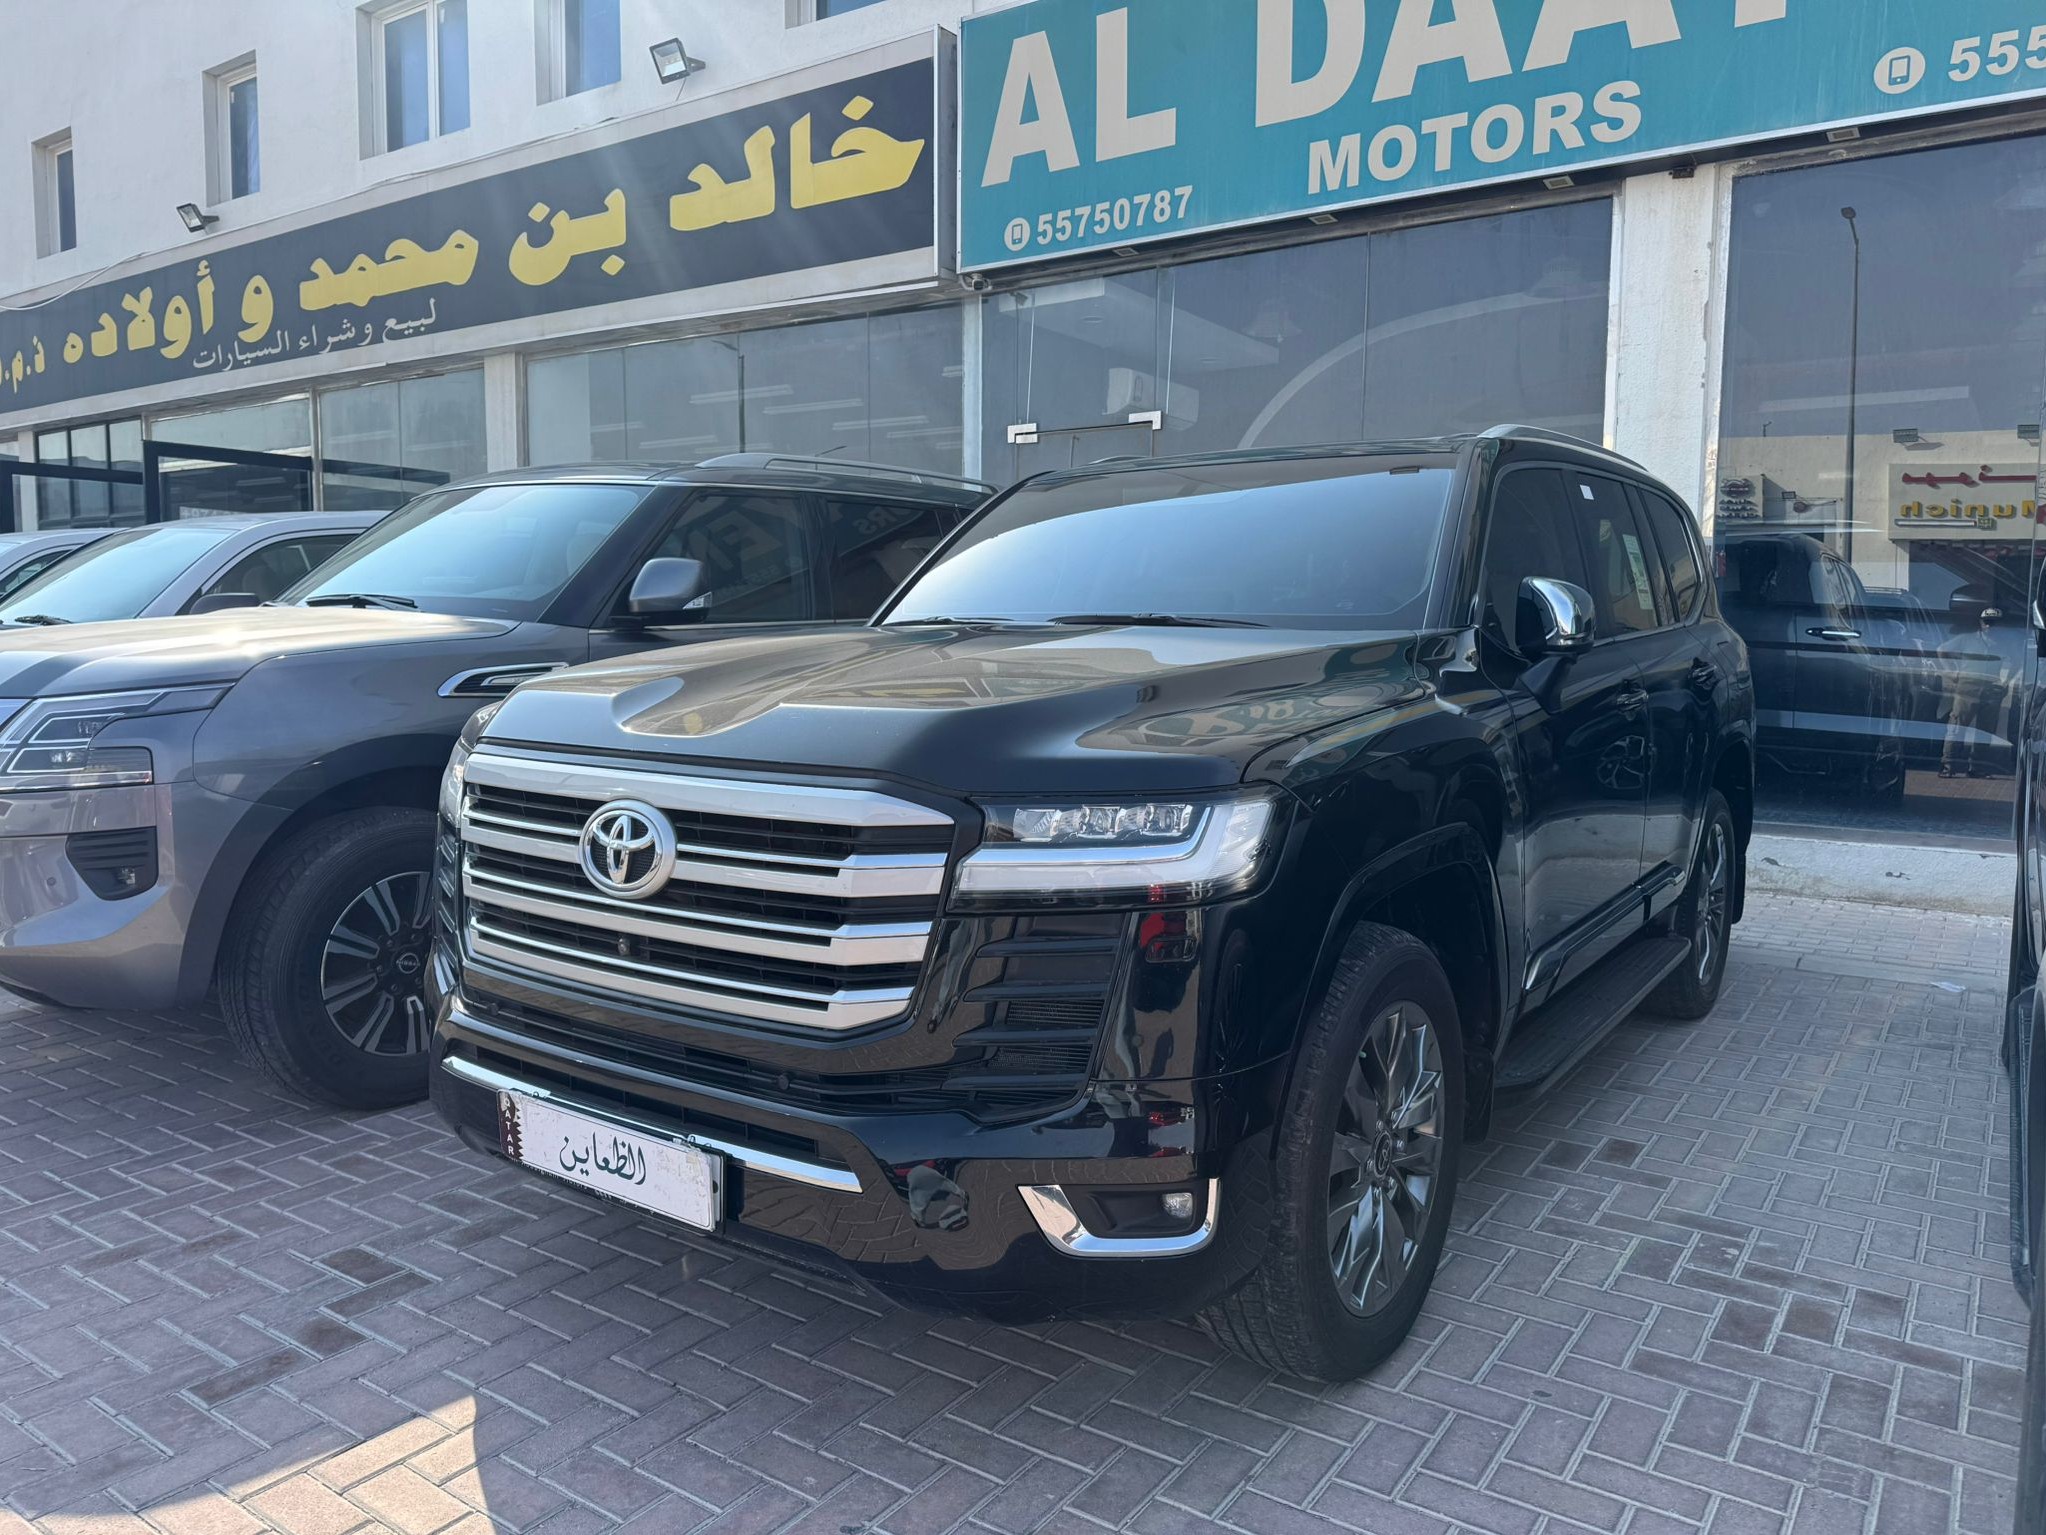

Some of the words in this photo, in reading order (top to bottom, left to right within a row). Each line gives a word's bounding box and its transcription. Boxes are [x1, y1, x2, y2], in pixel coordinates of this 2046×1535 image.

[1948, 24, 2046, 82] 555
[981, 7, 1176, 188] AL
[1255, 0, 1786, 128] DA
[669, 95, 925, 232] خالد
[1308, 80, 1642, 195] MOTORS
[508, 188, 627, 286] بن
[1036, 185, 1193, 246] 55750787
[299, 229, 480, 312] محمد
[63, 260, 215, 364] أولاده
[238, 274, 274, 343] و
[381, 297, 437, 344] لبيع
[0, 335, 46, 394] ذ.م.
[192, 329, 290, 371] السيارات
[503, 1097, 515, 1156] QATAR
[559, 1131, 647, 1186] الظعاين
